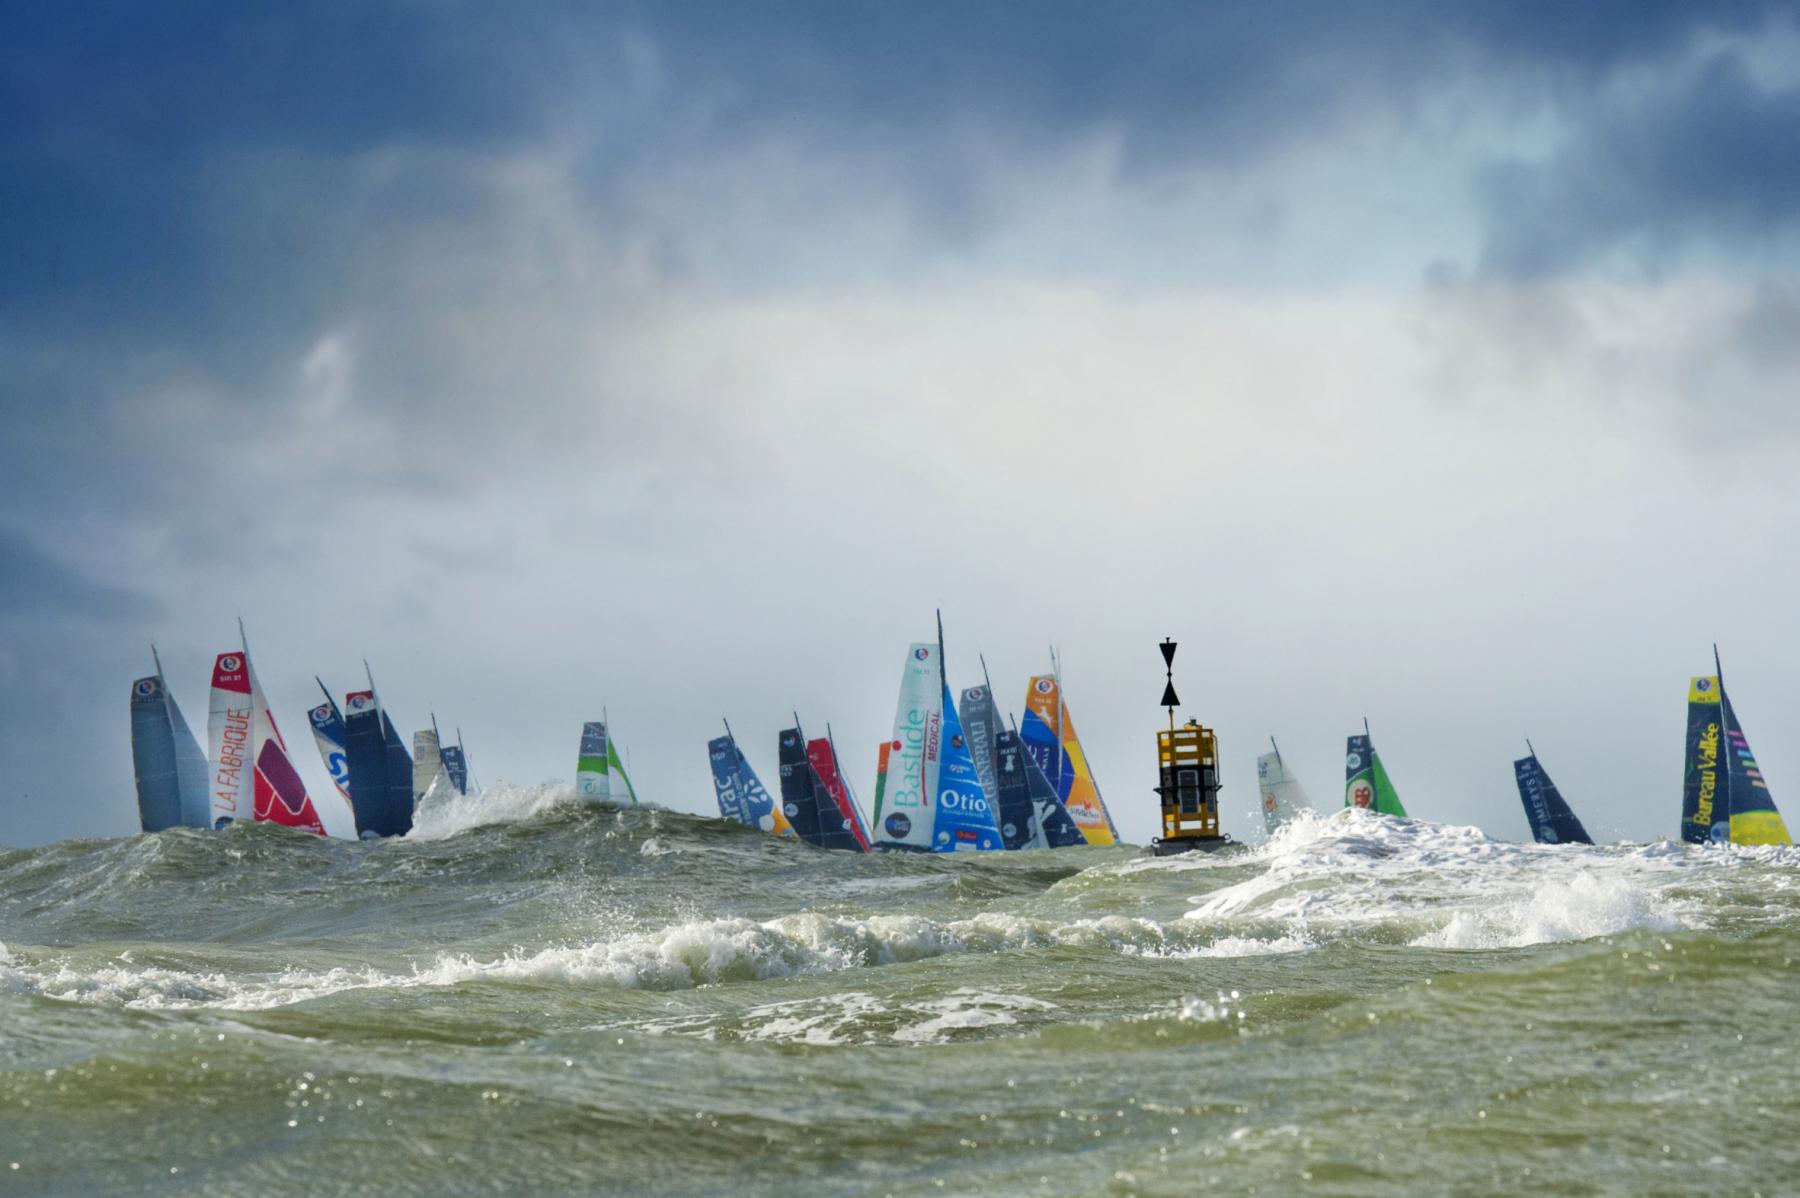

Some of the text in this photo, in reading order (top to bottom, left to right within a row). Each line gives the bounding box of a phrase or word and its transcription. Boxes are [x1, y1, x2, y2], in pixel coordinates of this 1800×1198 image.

[217, 708, 251, 788] FABRIQUE
[892, 708, 925, 808] Bastide
[927, 711, 940, 763] MÉDICAL
[971, 722, 996, 798] GENERALI
[1697, 722, 1720, 772] Vallée
[214, 790, 237, 813] LA
[940, 789, 987, 812] Otio
[1693, 769, 1717, 826] Bureau
